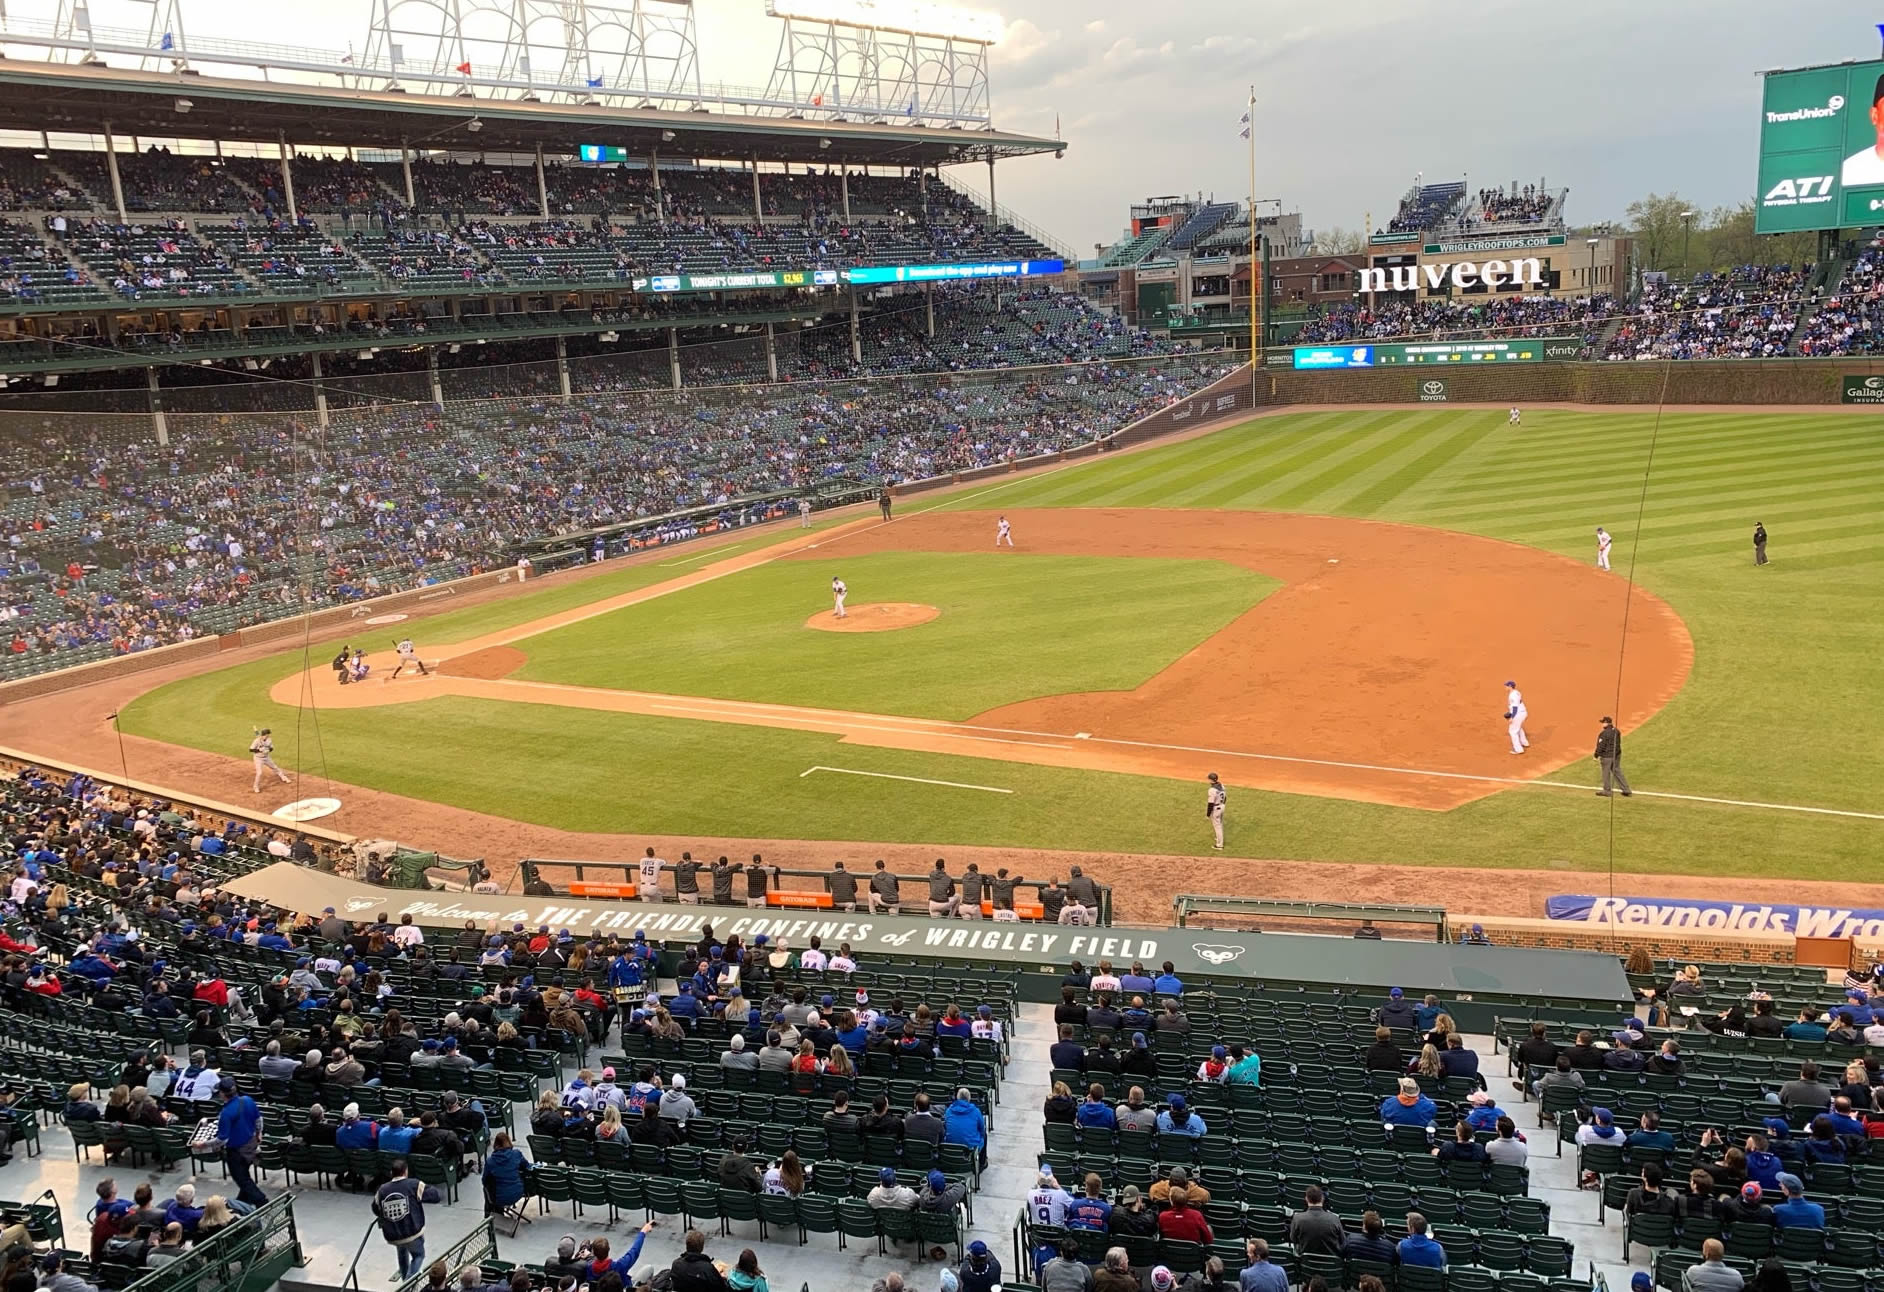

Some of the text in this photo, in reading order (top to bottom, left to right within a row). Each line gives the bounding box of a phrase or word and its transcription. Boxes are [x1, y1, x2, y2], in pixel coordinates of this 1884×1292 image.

[1766, 108, 1834, 123] TransUnion
[1764, 176, 1834, 200] ATI
[690, 276, 726, 288] TONIGHT'S
[727, 275, 757, 286] CURRENT
[757, 274, 777, 285] TOTAL
[1358, 257, 1544, 293] nuveen
[1546, 345, 1578, 357] xfinity
[641, 866, 655, 876] 45
[1587, 897, 1790, 932] Reynolds
[399, 902, 1158, 959] Welcome to THE FRIENDLY CONFINES of WRIGLEY FIELD
[1723, 1028, 1746, 1037] WISH
[176, 1080, 195, 1097] 44
[1038, 1207, 1051, 1225] 9
